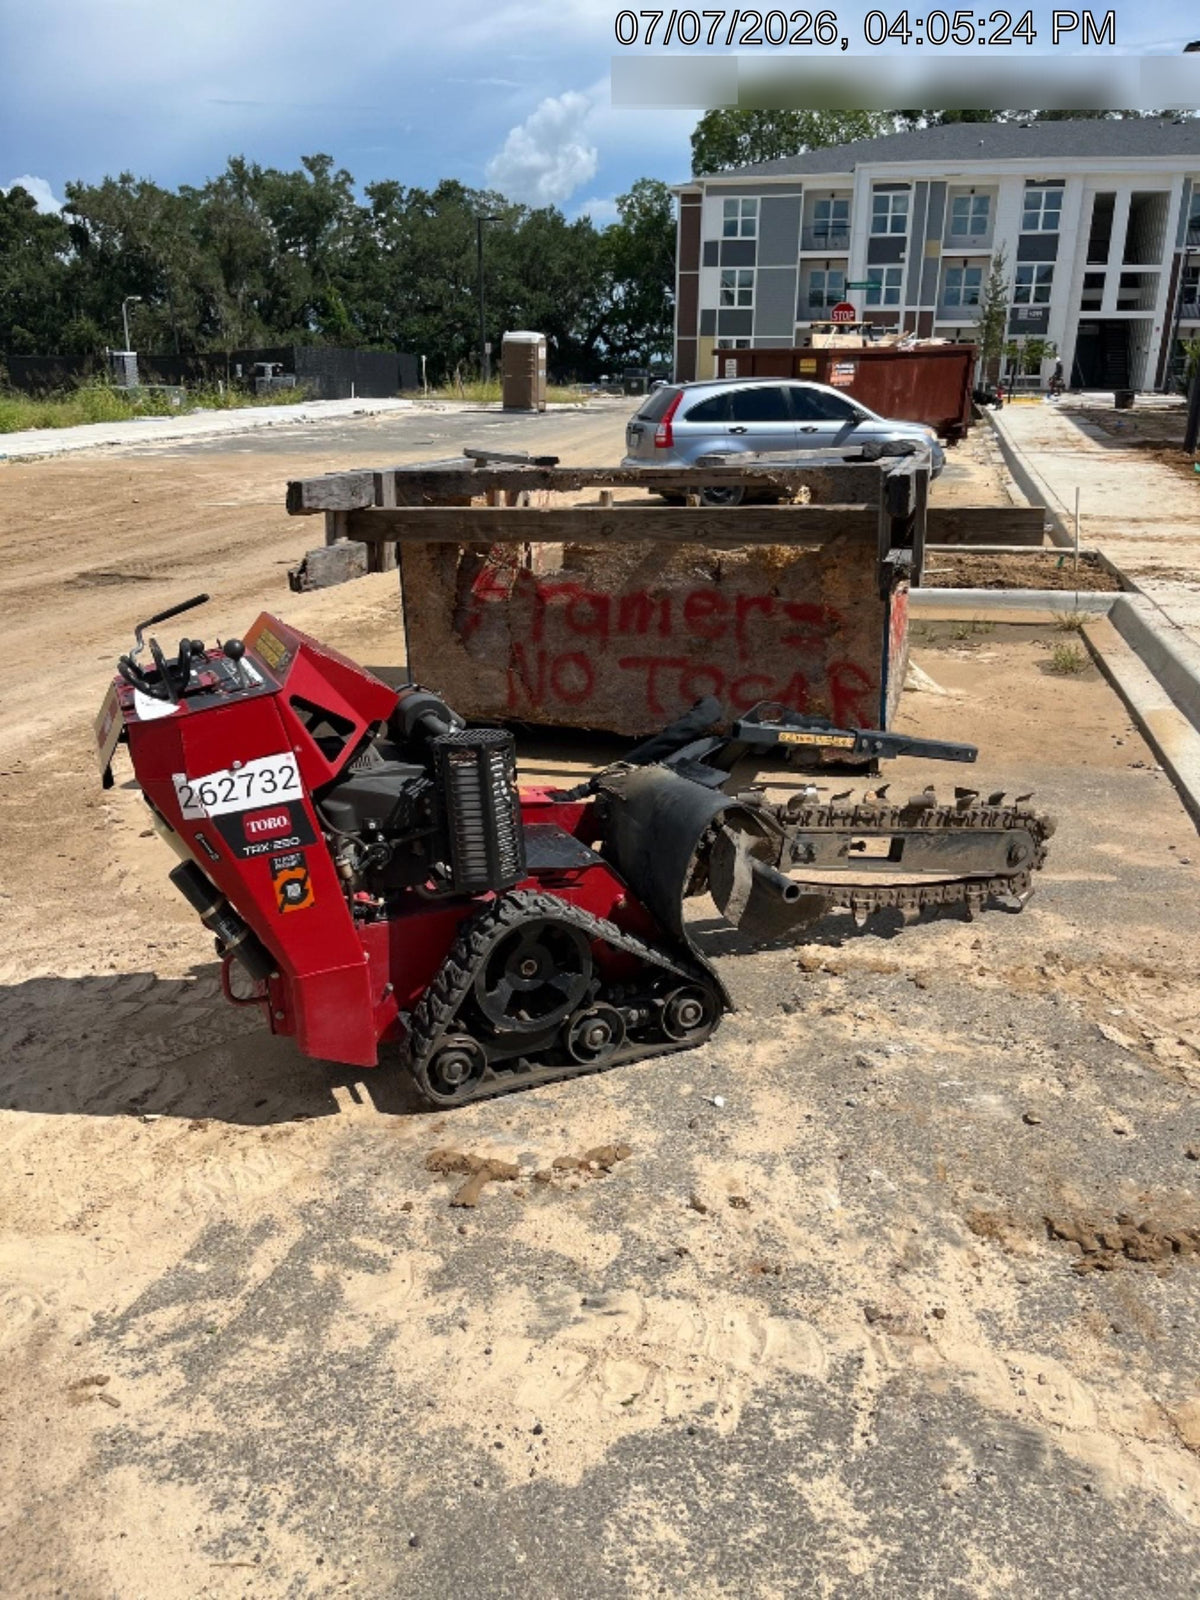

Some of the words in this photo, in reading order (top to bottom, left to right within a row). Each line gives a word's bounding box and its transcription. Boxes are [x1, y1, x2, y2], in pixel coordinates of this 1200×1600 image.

[833, 310, 855, 321] STOP
[507, 642, 597, 709] NO
[618, 657, 876, 729] TOCAR
[178, 765, 299, 810] 262732
[246, 815, 289, 833] TORO
